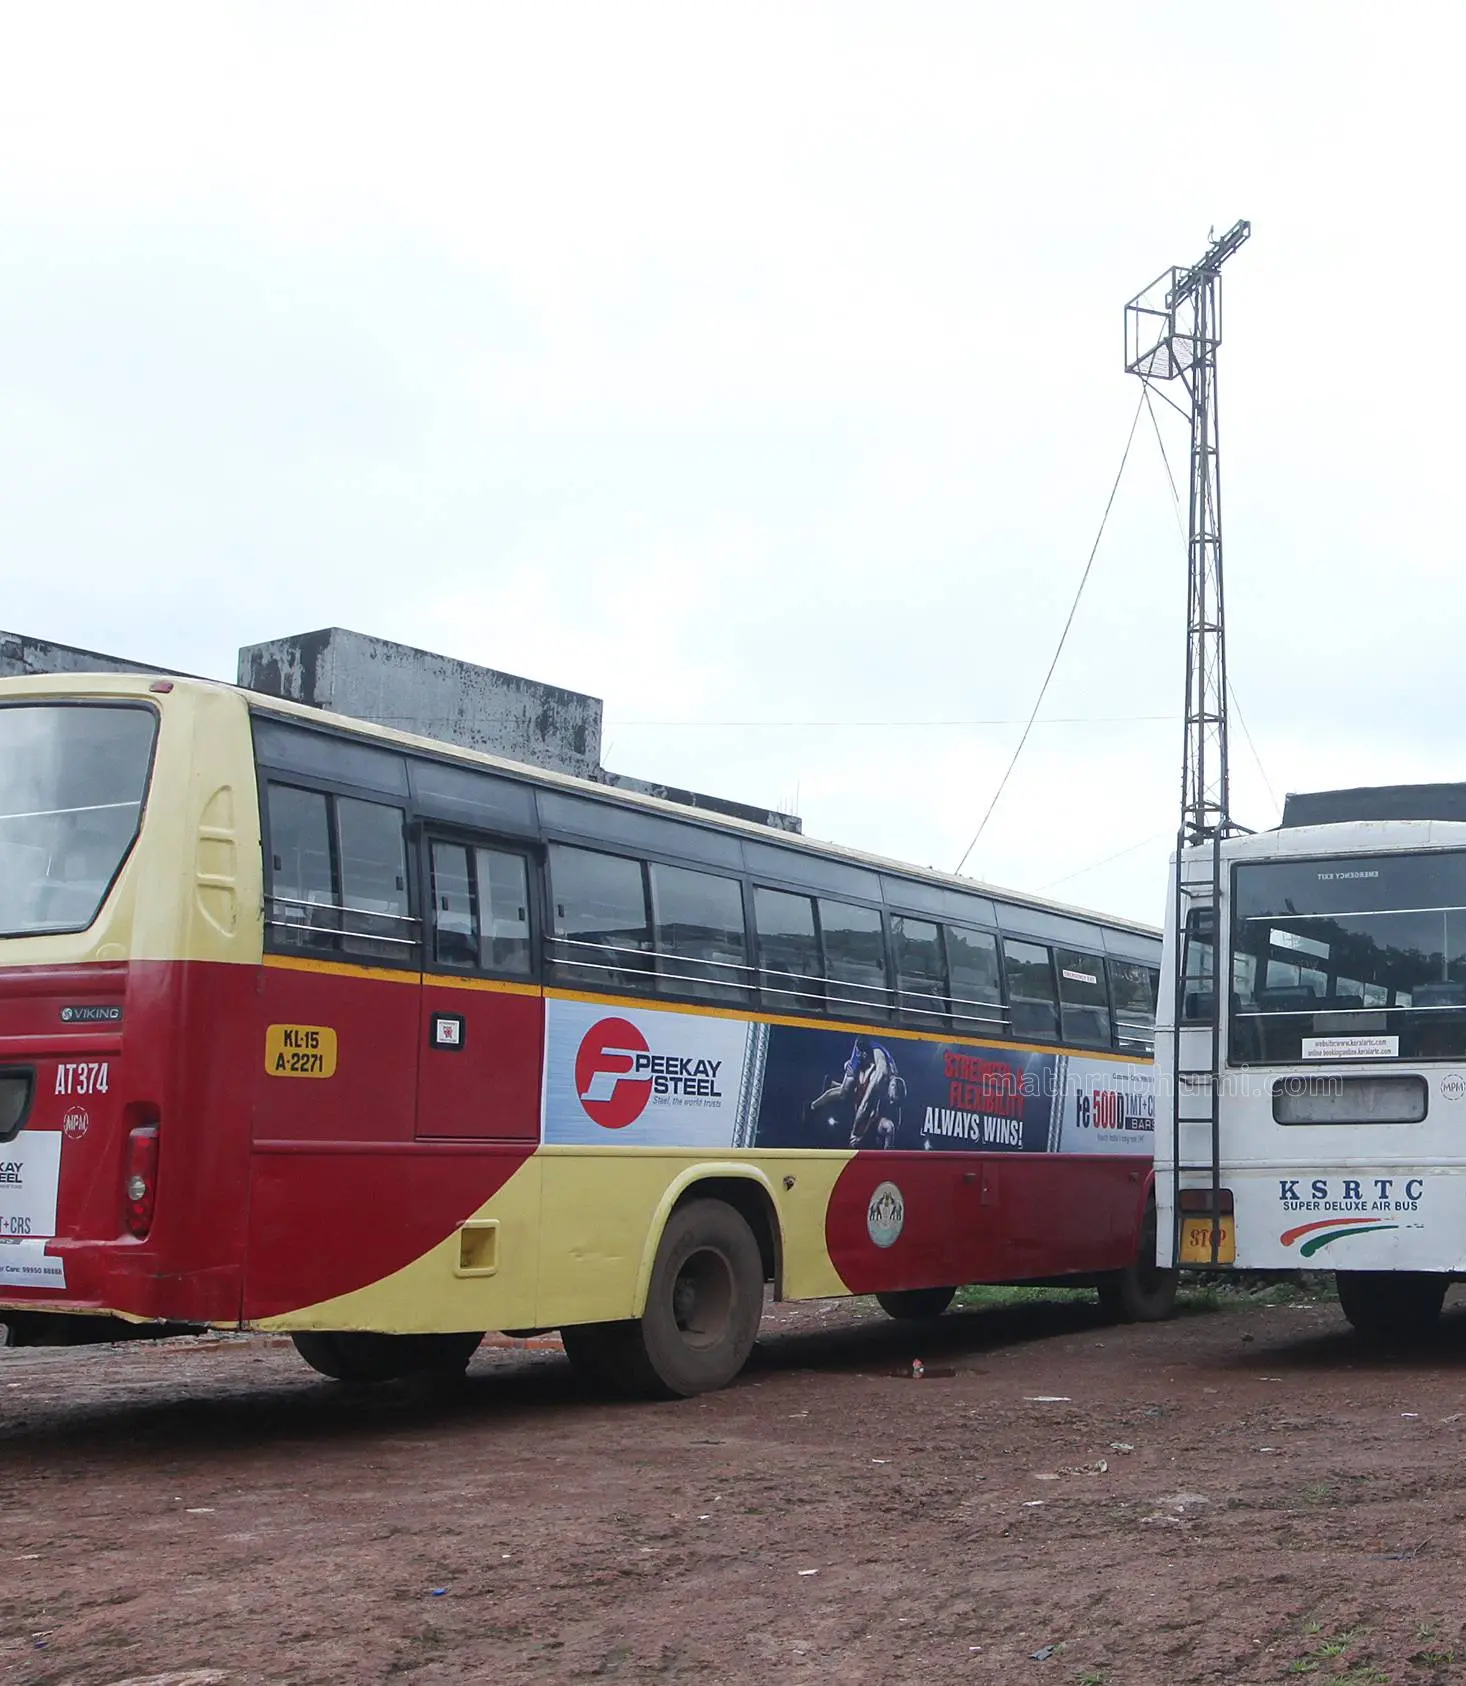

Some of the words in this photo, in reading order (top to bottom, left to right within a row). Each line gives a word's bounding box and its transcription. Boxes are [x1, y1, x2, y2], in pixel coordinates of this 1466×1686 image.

[74, 1008, 120, 1019] VIKING
[635, 1054, 722, 1079] PEEKAY
[652, 1076, 722, 1097] STEEL
[1443, 1081, 1464, 1093] MPM
[923, 1107, 980, 1141] ALWAYS
[983, 1115, 1024, 1148] WINS!
[1283, 1201, 1320, 1211] SUPER
[1324, 1201, 1368, 1211] DELUXE
[1371, 1201, 1391, 1211] AIR
[1395, 1201, 1418, 1211] BUS
